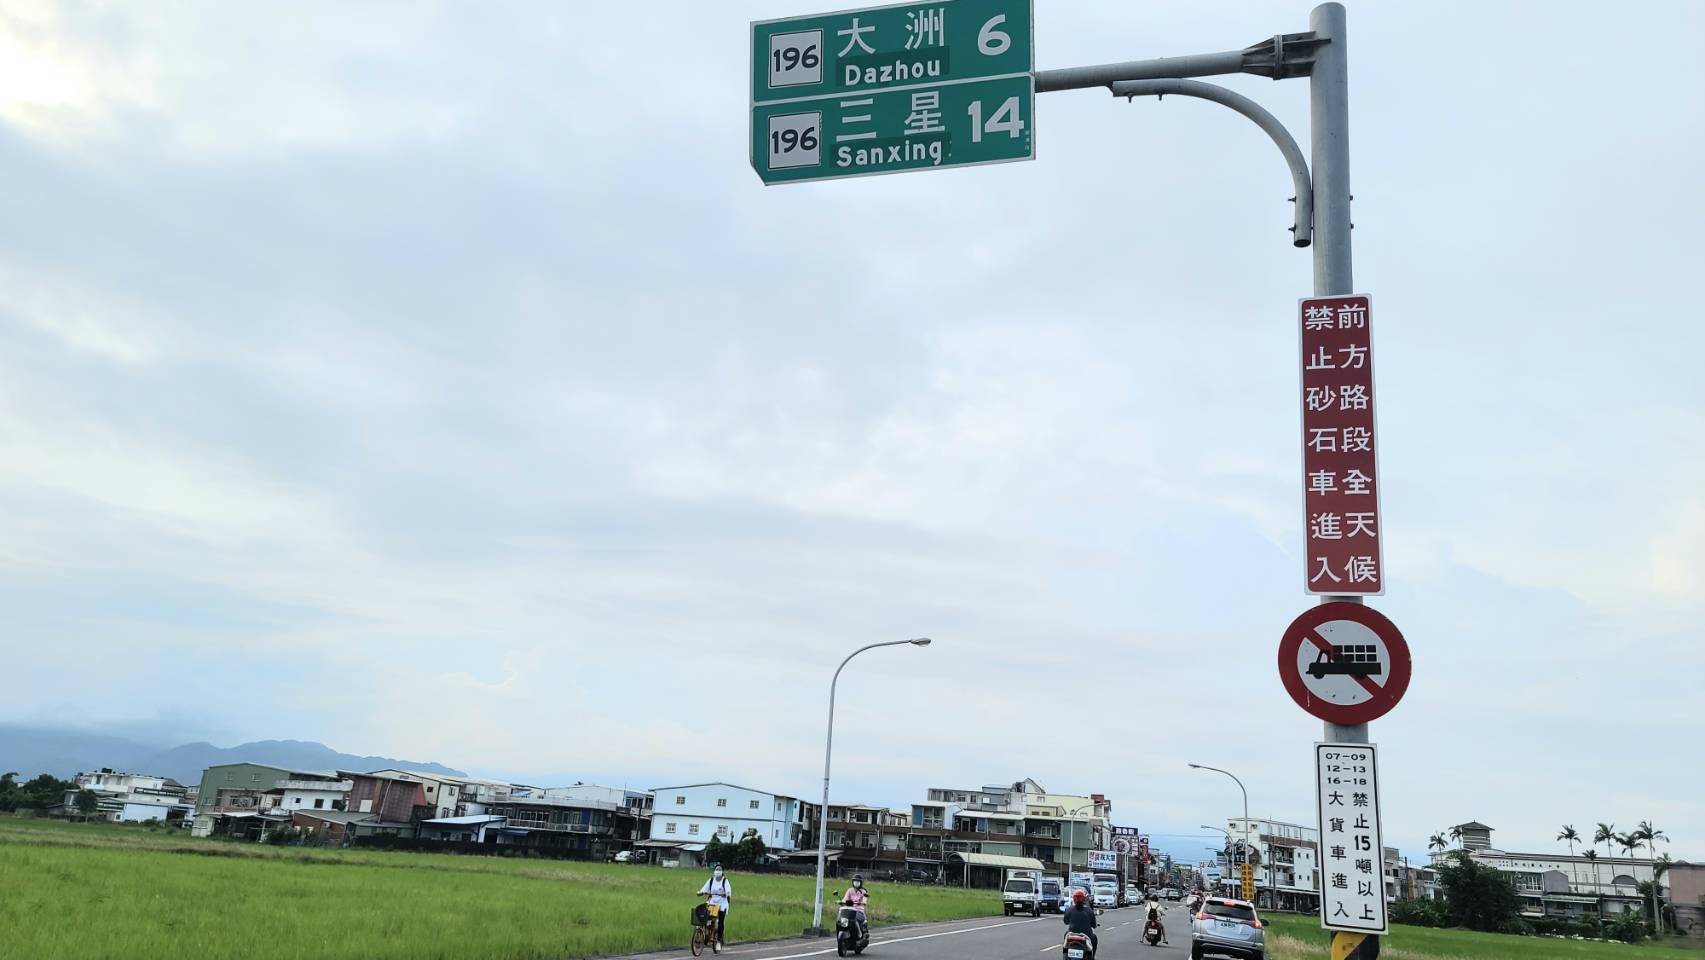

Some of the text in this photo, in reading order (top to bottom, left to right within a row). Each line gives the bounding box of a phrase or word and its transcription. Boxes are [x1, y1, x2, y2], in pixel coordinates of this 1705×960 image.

[837, 8, 945, 58] 大洲
[977, 14, 1011, 56] 6
[773, 44, 819, 73] 196
[845, 59, 941, 86] Dazhou
[836, 91, 946, 142] 三星
[967, 96, 1024, 143] 14
[771, 126, 818, 154] 196
[836, 140, 942, 168] Sanxing
[1305, 305, 1342, 583] 禁止砂石車進入
[1337, 303, 1377, 583] 前方路段全天候
[1325, 753, 1366, 761] 07-09
[1327, 765, 1366, 773] 12-13
[1327, 777, 1367, 786] 16-18
[1328, 790, 1349, 918] 大貨車進入
